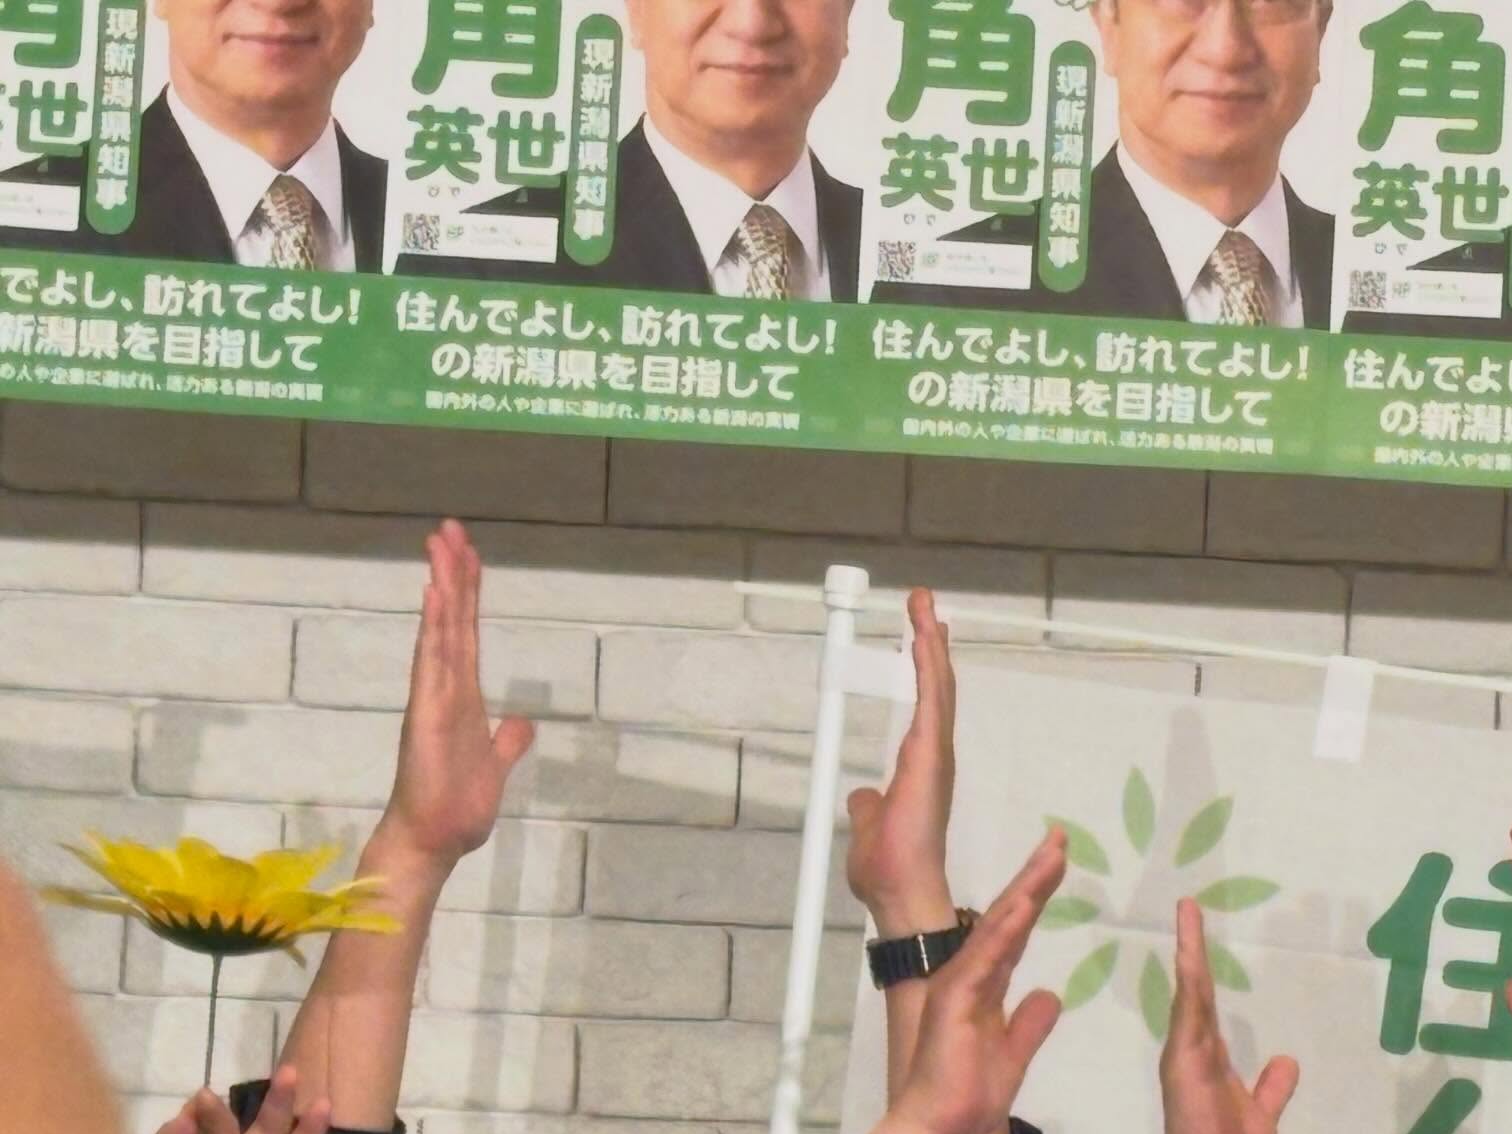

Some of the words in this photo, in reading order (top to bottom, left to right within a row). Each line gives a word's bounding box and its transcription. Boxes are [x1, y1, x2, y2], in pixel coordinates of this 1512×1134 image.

[887, 0, 1036, 126] 角
[1358, 0, 1507, 155] 角
[0, 79, 88, 158] 世
[407, 105, 565, 187] 英世
[881, 132, 1039, 214] 英世
[1352, 161, 1510, 243] 英世
[433, 344, 797, 398] の新潟県を目指して
[908, 371, 1272, 425] の新潟県を目指して
